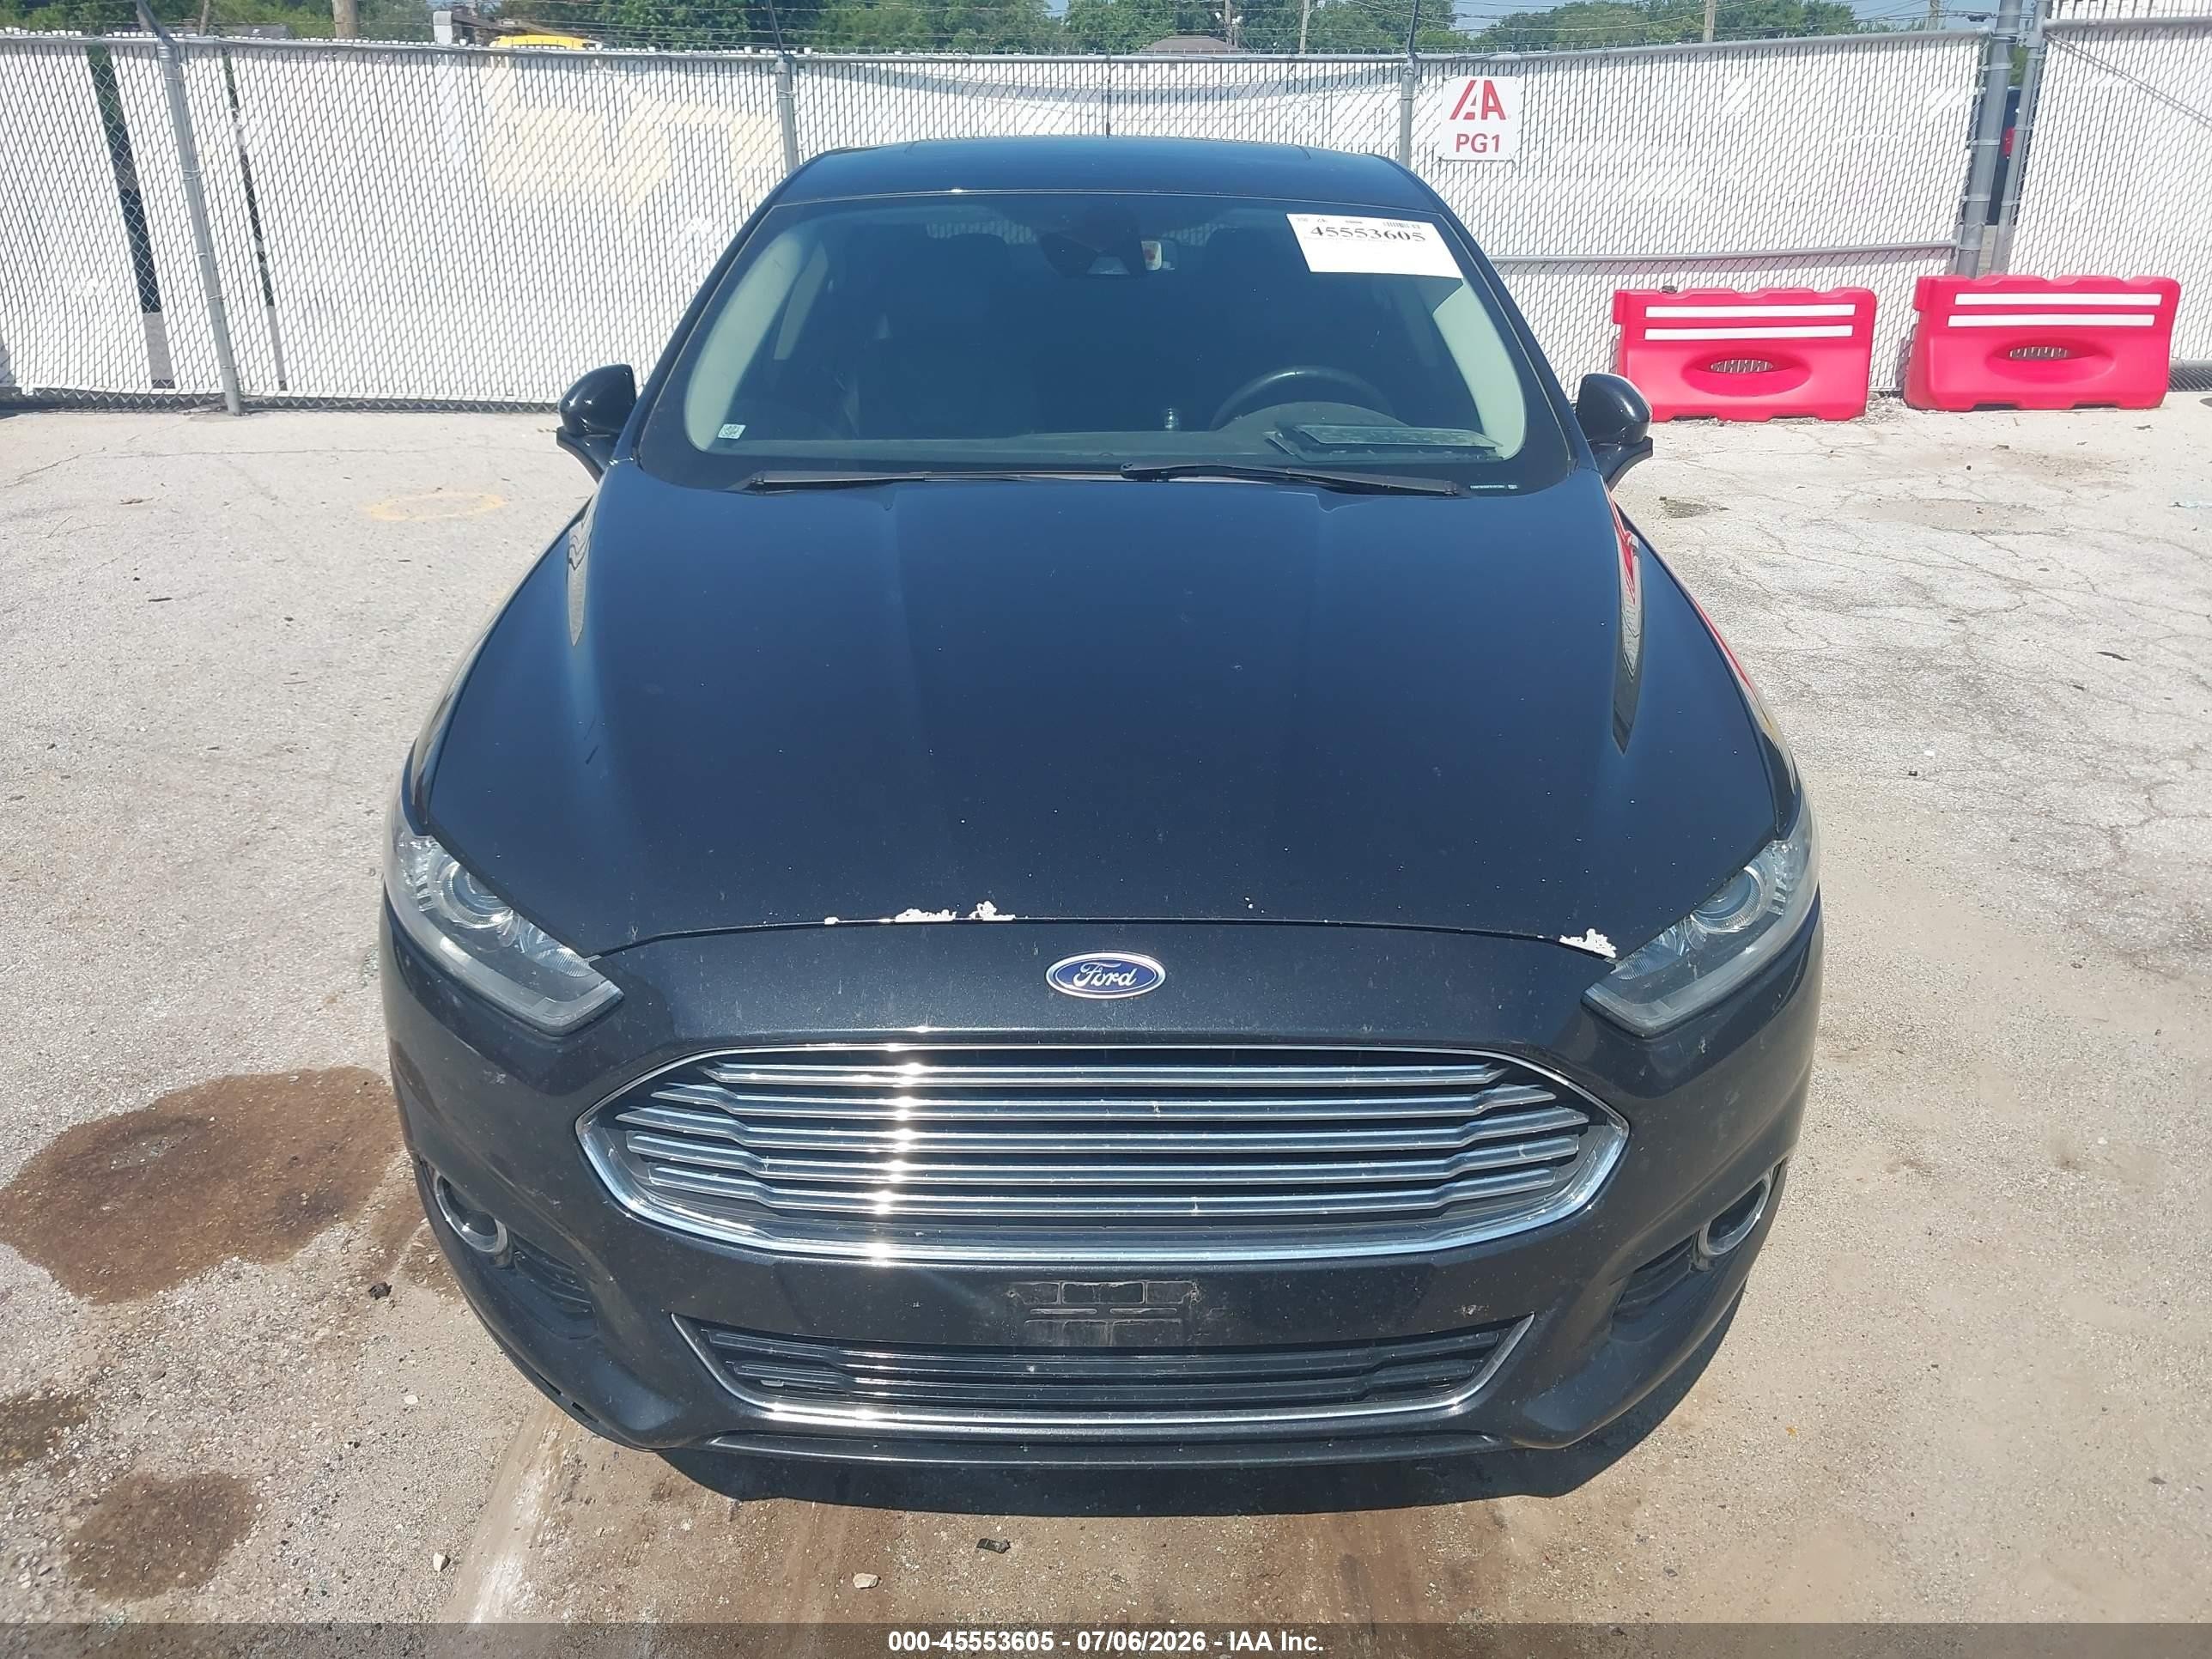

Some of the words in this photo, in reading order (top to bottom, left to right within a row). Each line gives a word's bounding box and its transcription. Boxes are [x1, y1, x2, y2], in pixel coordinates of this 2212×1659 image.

[1455, 133, 1500, 153] PG1
[1310, 226, 1426, 241] 45553605
[1073, 962, 1138, 987] Ford
